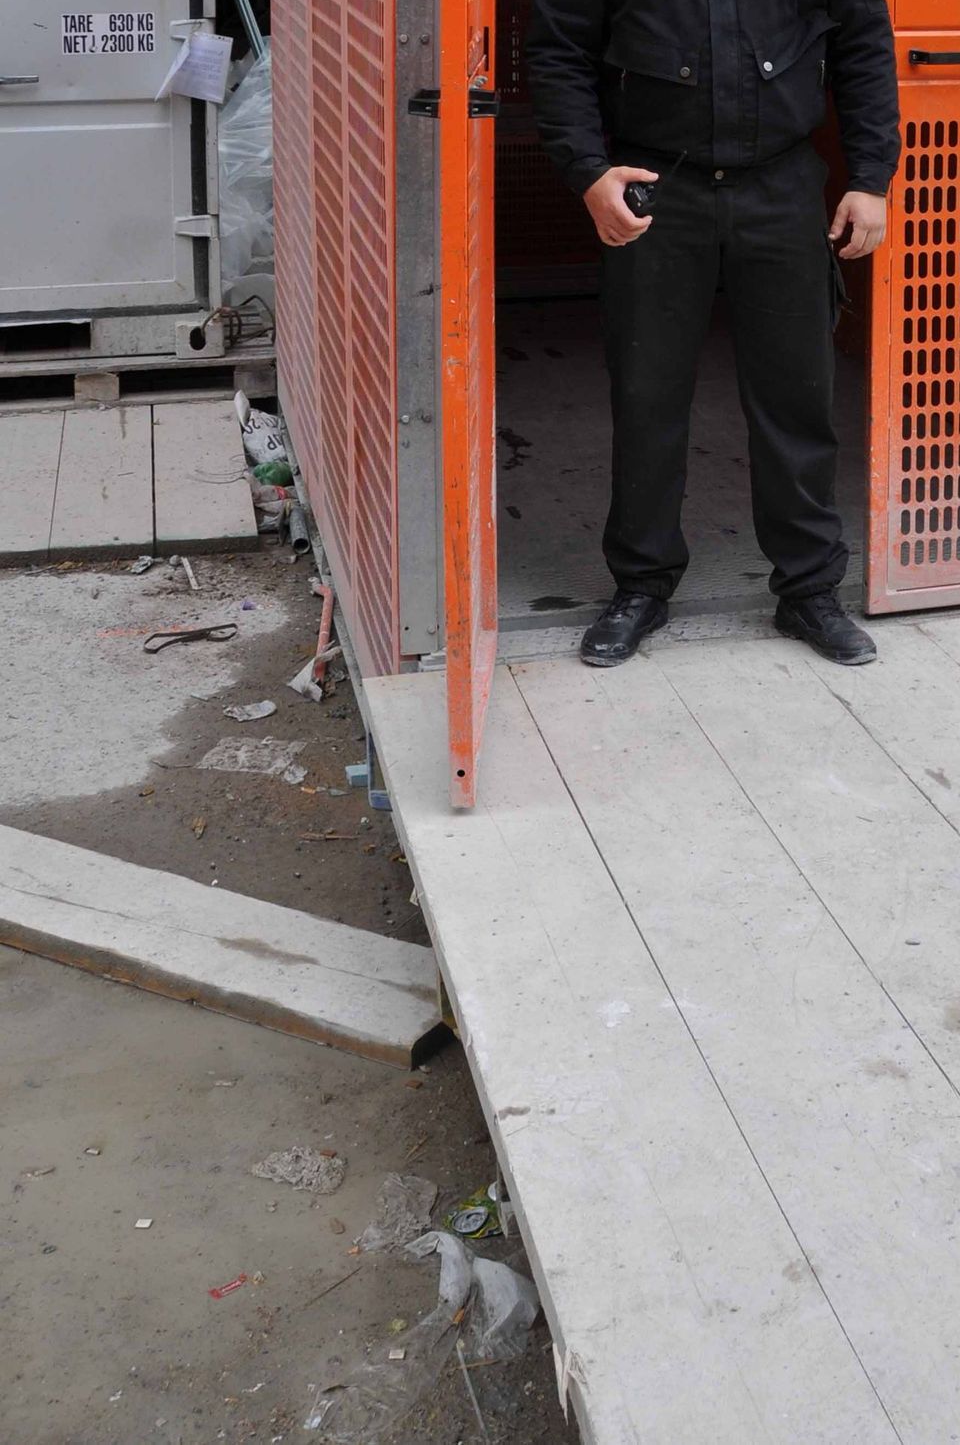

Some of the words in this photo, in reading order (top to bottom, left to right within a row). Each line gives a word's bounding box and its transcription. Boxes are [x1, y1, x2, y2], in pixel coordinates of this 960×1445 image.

[62, 14, 94, 33] TARE
[109, 13, 134, 32] 630
[137, 13, 154, 32] KG
[101, 34, 134, 53] 2300
[137, 33, 154, 52] KG
